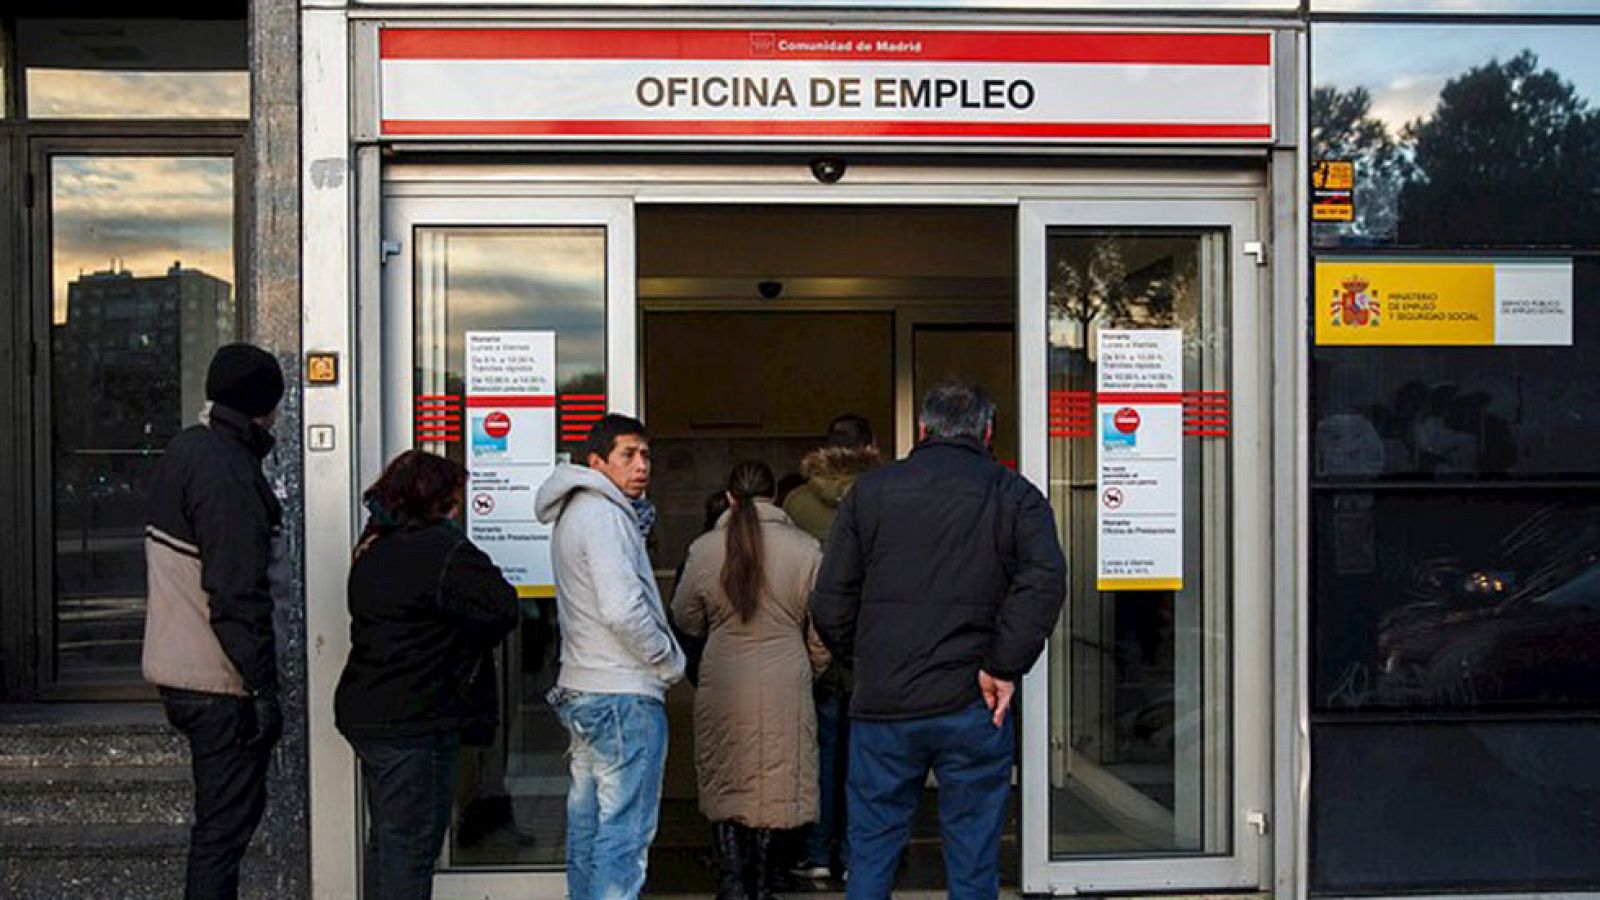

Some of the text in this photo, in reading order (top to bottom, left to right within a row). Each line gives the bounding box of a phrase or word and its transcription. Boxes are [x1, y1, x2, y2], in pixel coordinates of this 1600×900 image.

[778, 40, 921, 52] Comunidad de Madrid
[636, 76, 1035, 109] OFICINA DE EMPLEO
[1387, 302, 1436, 310] DE EMPLEO
[1388, 312, 1479, 320] Y SEGURIDAD SOCIAL
